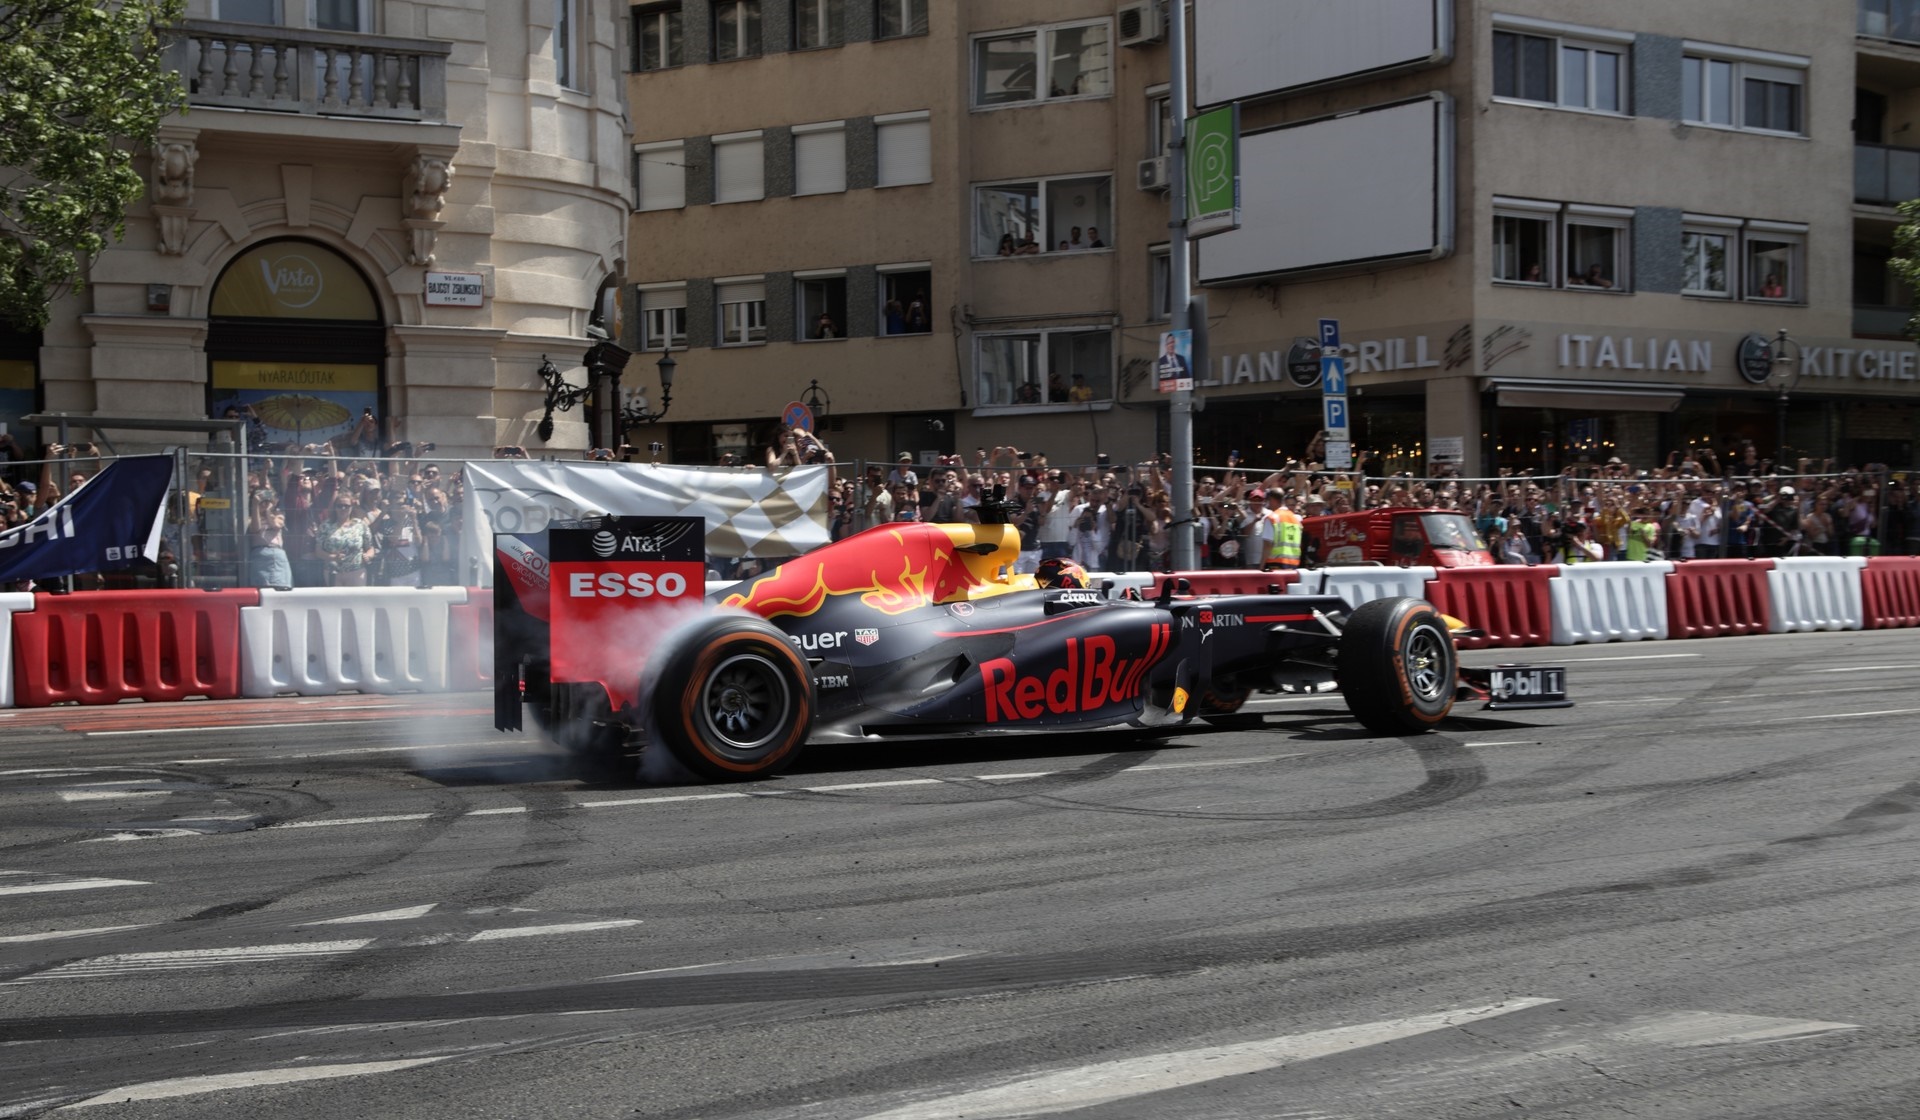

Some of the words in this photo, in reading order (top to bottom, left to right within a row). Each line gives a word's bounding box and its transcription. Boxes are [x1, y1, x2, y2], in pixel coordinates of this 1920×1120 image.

[260, 259, 315, 295] Vista
[1323, 324, 1336, 344] P
[1340, 336, 1440, 376] GRILL
[1558, 333, 1713, 372] ITALIAN
[1800, 346, 1920, 380] KITCHE
[258, 368, 335, 384] NYARALÓUTAK
[1330, 403, 1342, 424] P
[621, 535, 664, 552] AT&T
[511, 561, 549, 590] ORGANICS
[570, 572, 687, 597] ESSO
[821, 675, 849, 688] IBM
[1491, 670, 1542, 698] Mobil
